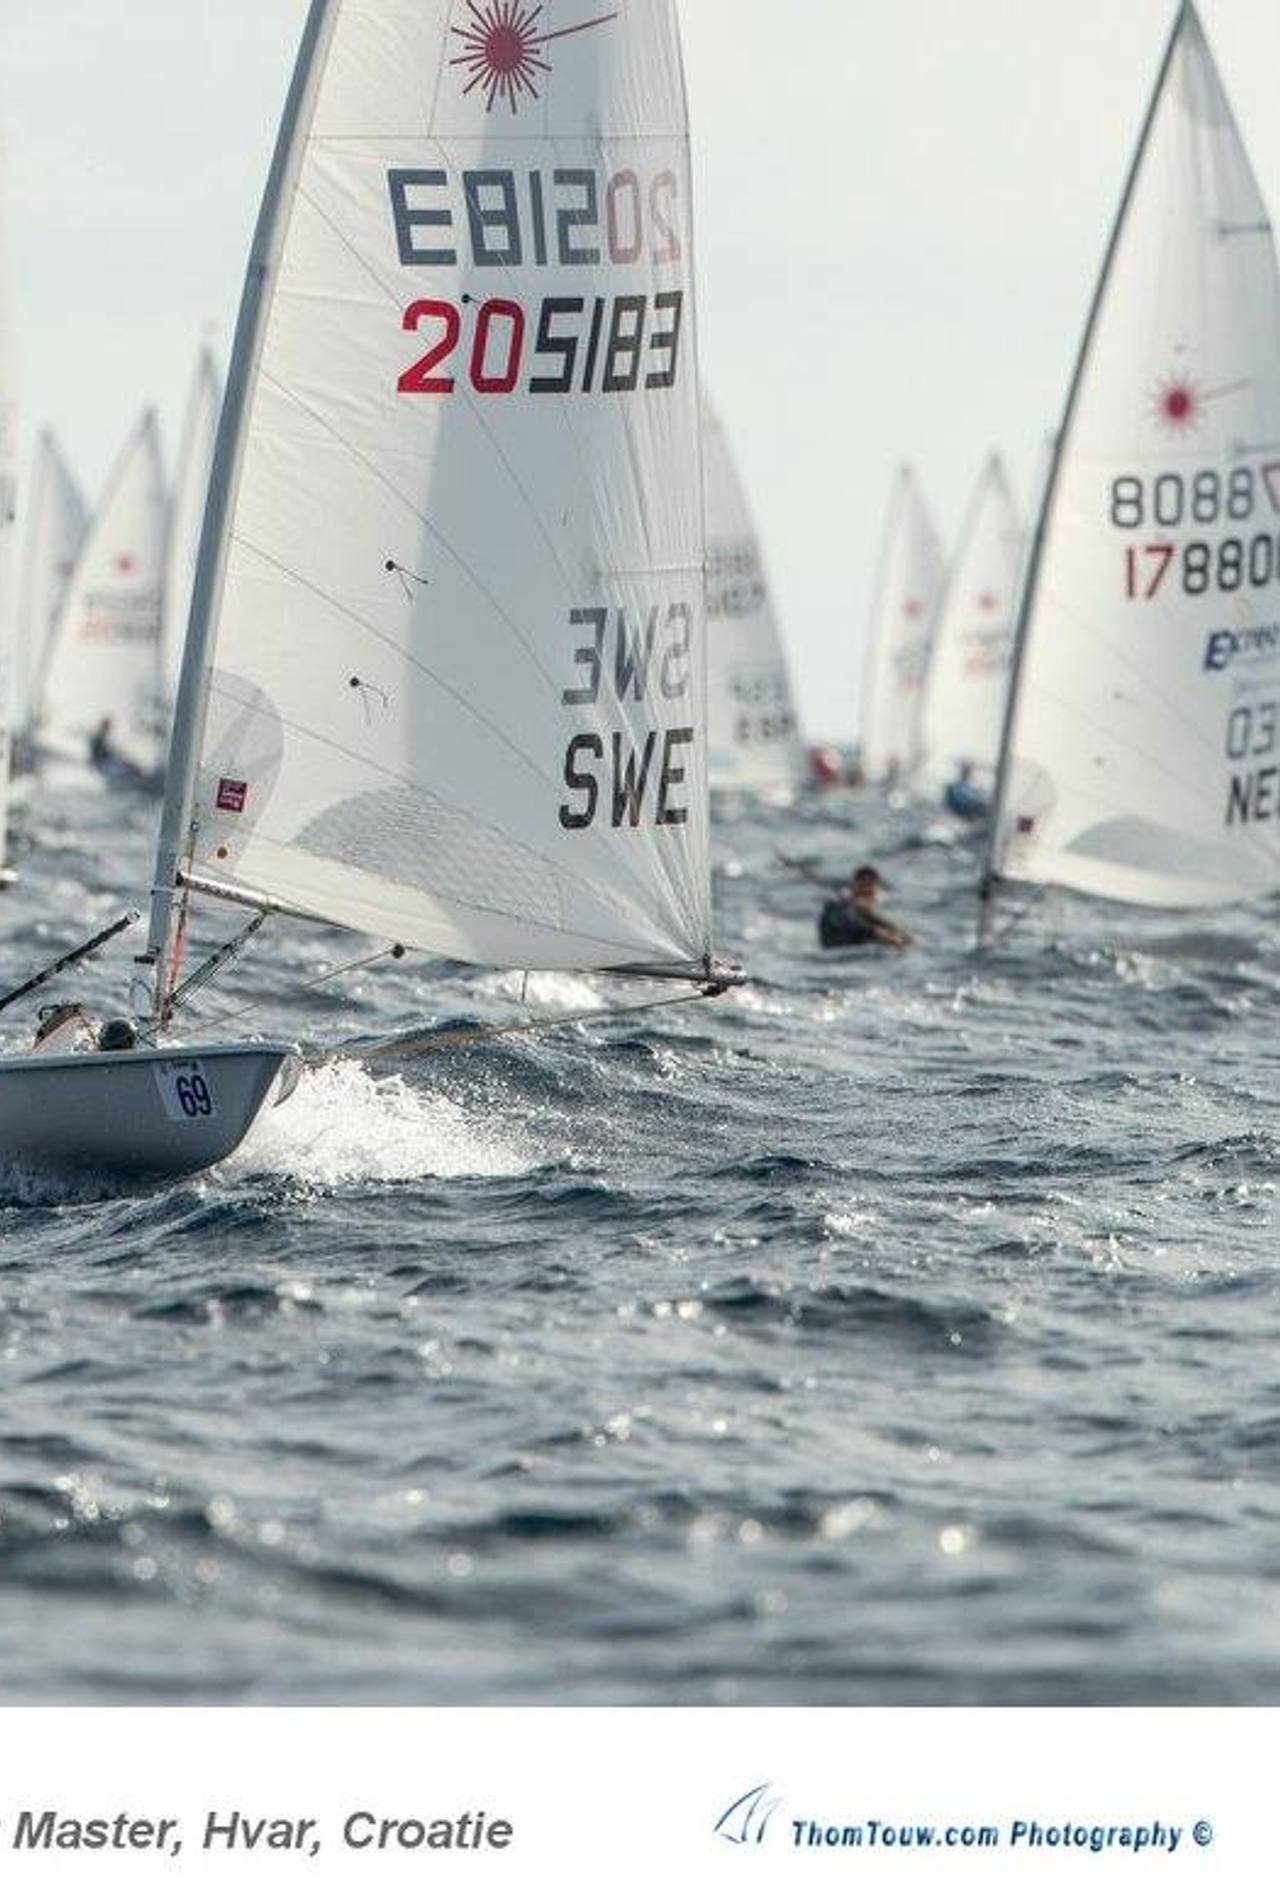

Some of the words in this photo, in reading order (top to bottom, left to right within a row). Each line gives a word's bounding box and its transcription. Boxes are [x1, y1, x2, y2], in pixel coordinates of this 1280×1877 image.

[396, 290, 684, 394] 205183
[1125, 533, 1280, 600] 17880
[558, 727, 695, 830] SWE
[1225, 766, 1280, 827] NE
[175, 1073, 212, 1118] 69
